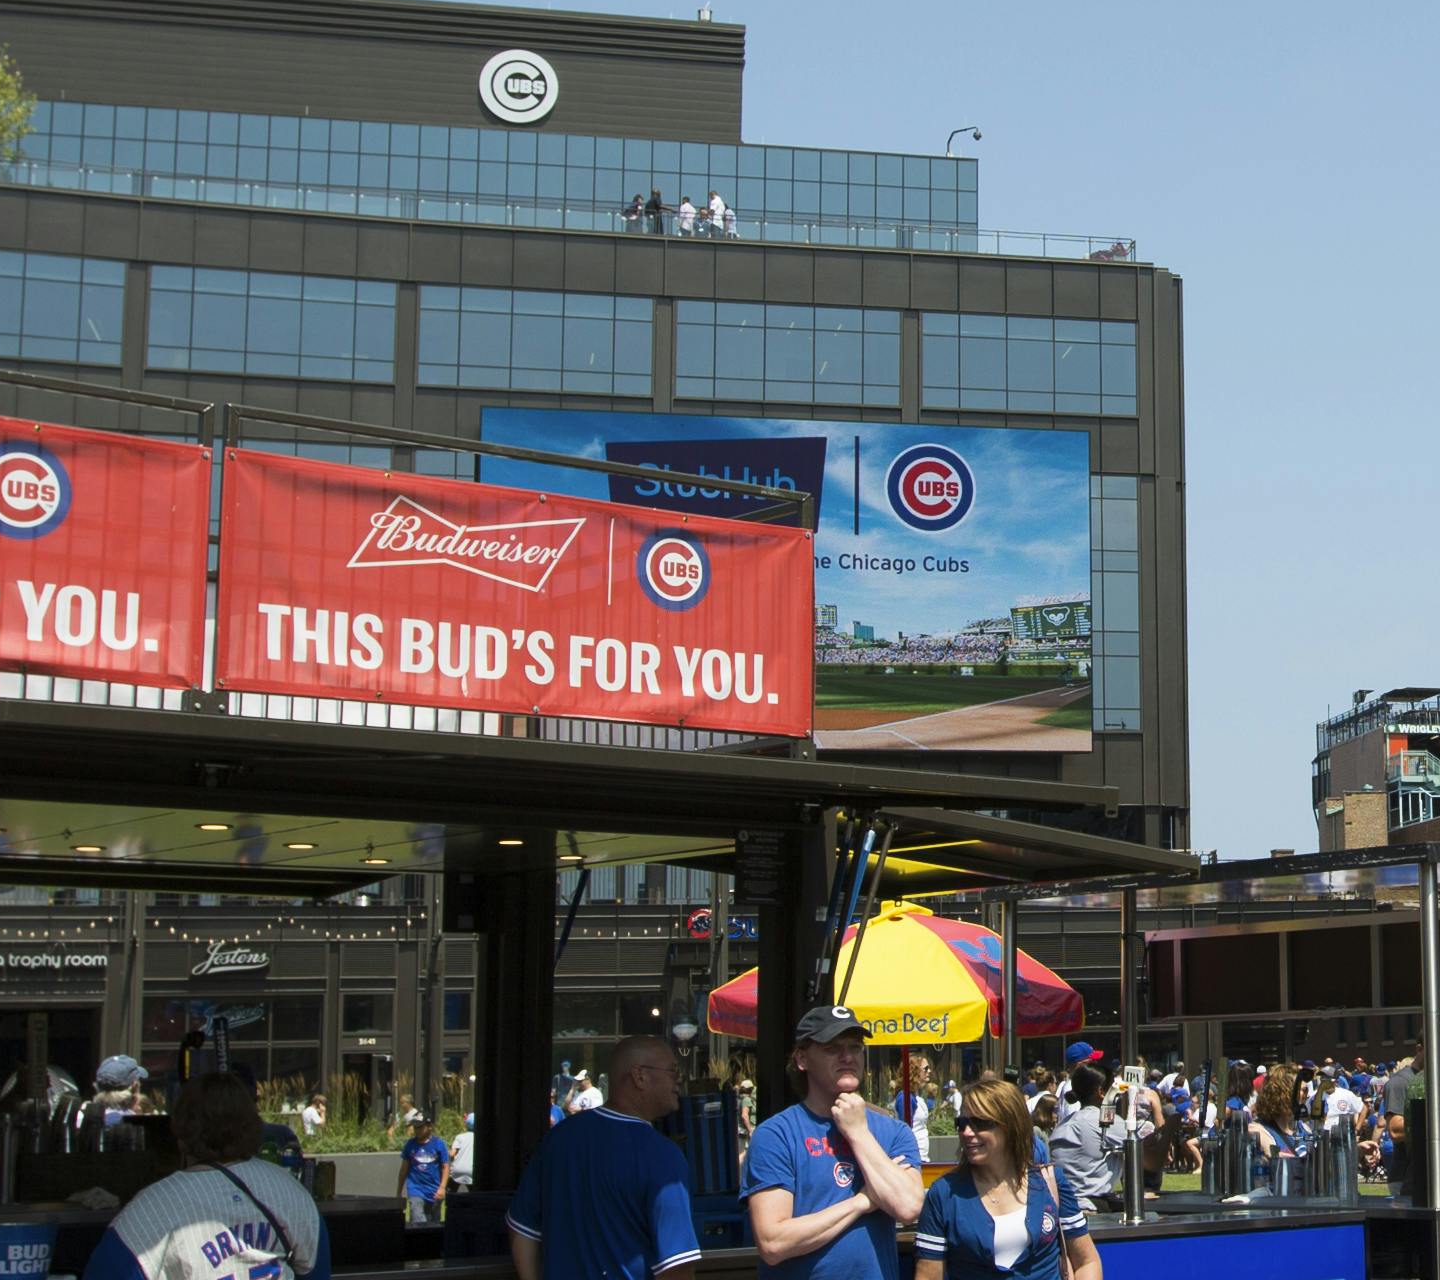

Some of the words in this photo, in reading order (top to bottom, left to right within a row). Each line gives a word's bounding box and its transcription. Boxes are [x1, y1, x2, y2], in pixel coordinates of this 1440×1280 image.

[371, 511, 562, 566] Budweiser
[839, 553, 916, 575] Chicago
[923, 556, 970, 573] Cubs
[15, 580, 160, 653] YOU.
[258, 602, 384, 671] THIS
[400, 617, 556, 684] BUD'S
[569, 636, 661, 693] FOR
[674, 646, 780, 705] YOU.
[8, 952, 60, 969] trophy
[64, 954, 108, 967] room
[831, 1006, 851, 1019] C
[903, 1012, 950, 1038] Beef
[7, 1243, 50, 1261] BUD
